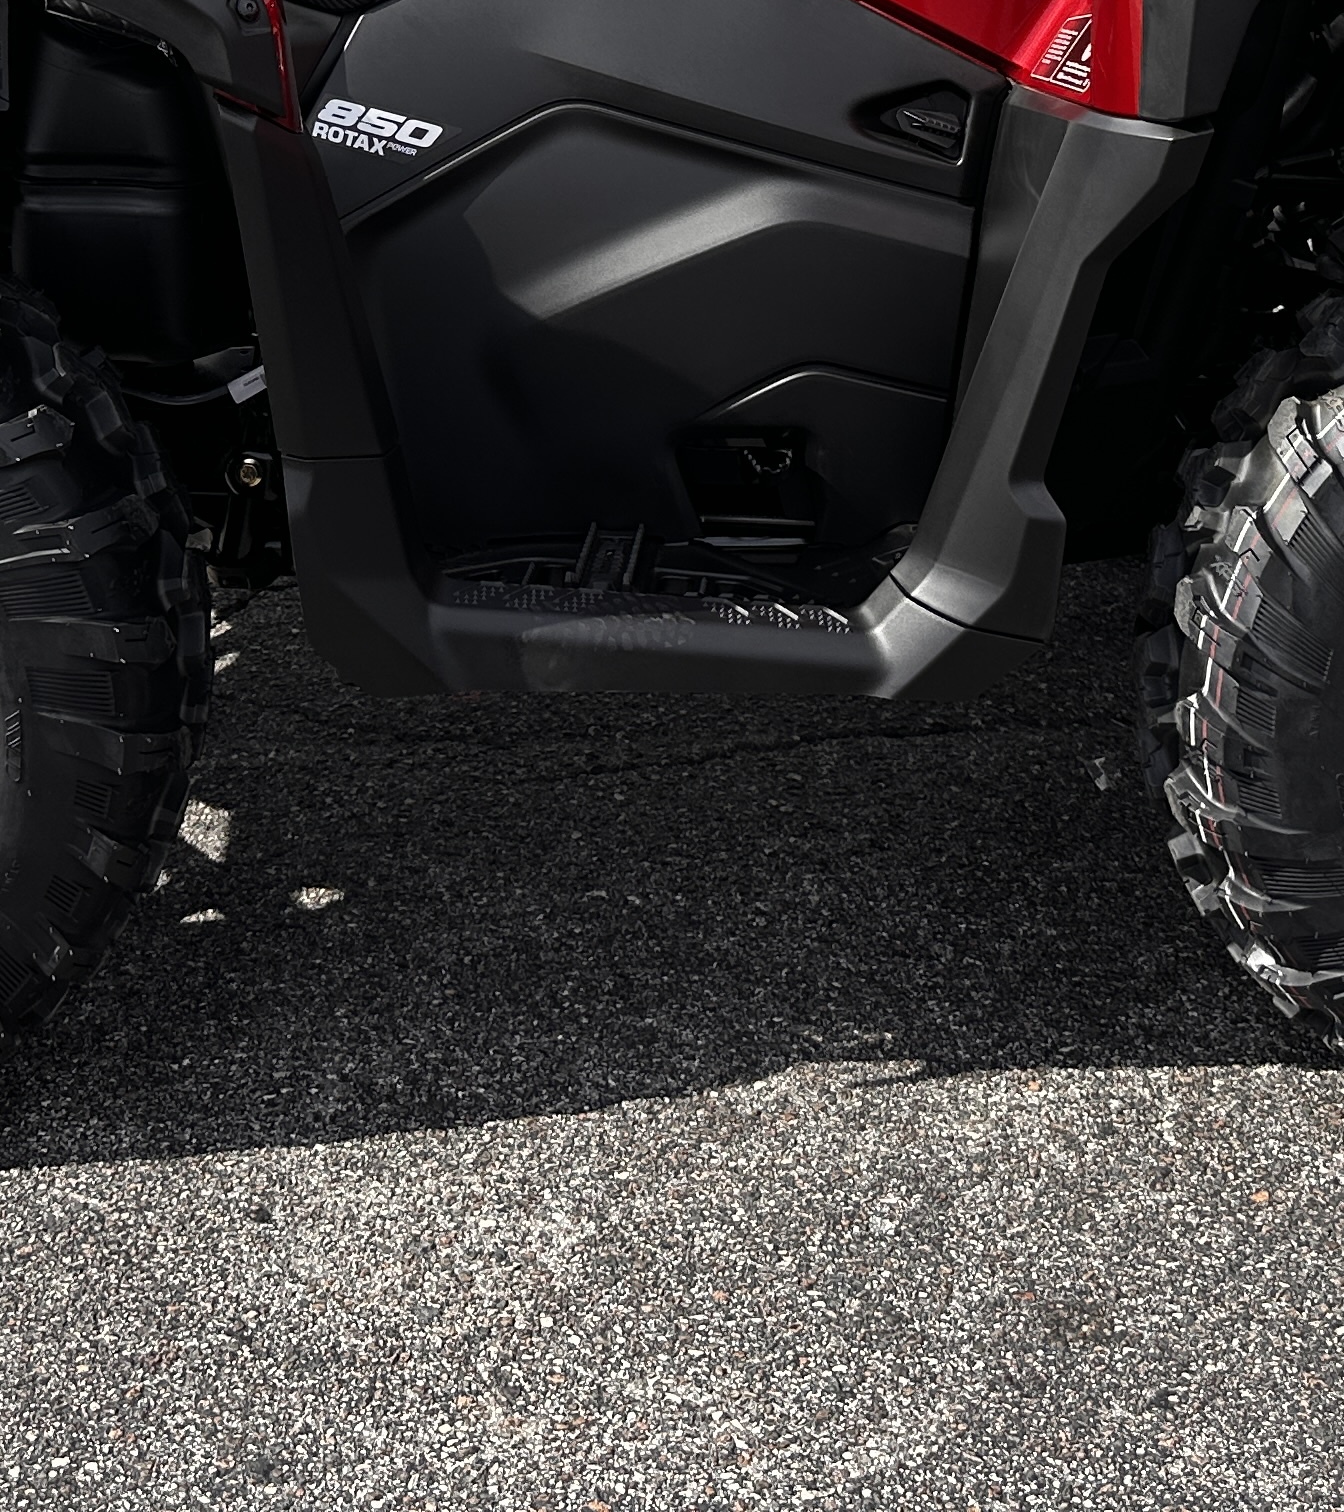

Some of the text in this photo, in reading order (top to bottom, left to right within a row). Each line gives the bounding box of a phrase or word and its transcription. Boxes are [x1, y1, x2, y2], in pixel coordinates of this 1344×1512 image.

[311, 121, 418, 156] ROTAX POWER
[317, 98, 444, 148] 850
